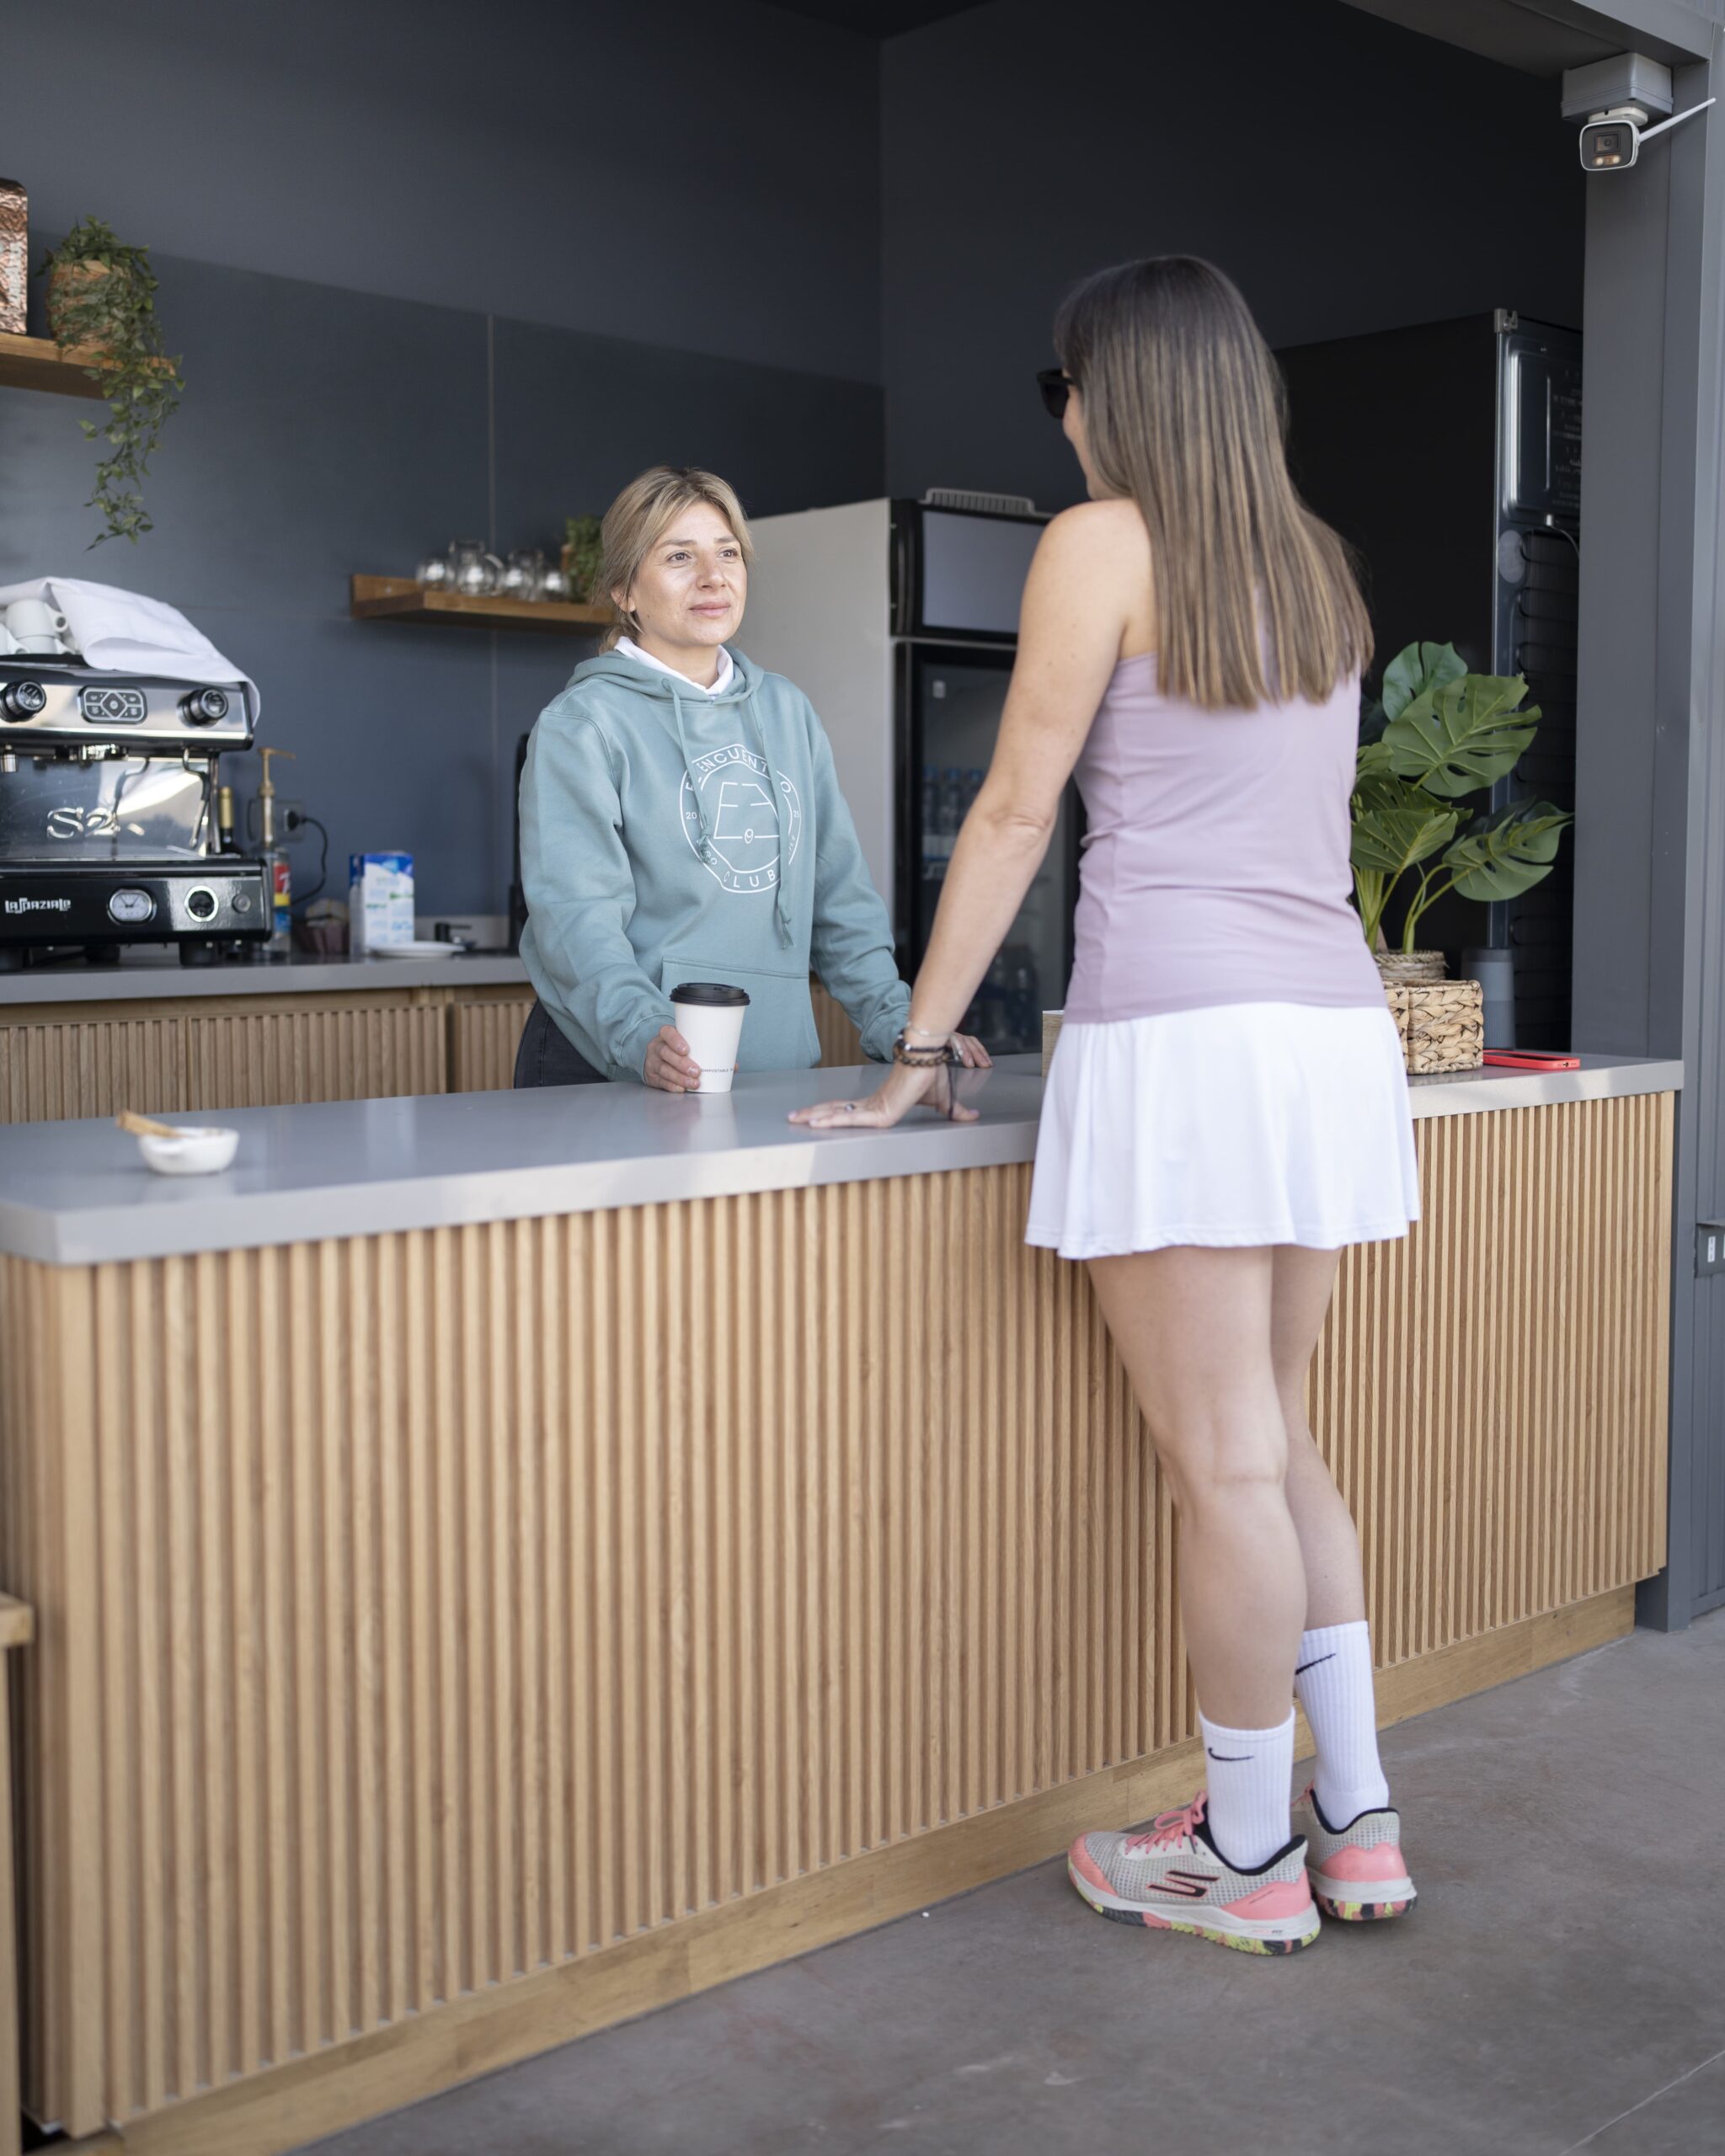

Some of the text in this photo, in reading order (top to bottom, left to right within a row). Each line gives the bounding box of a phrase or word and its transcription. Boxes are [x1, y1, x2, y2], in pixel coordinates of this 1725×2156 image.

[696, 747, 792, 793] ENCUENTO
[685, 811, 697, 819] 20
[724, 869, 776, 889] CLUB
